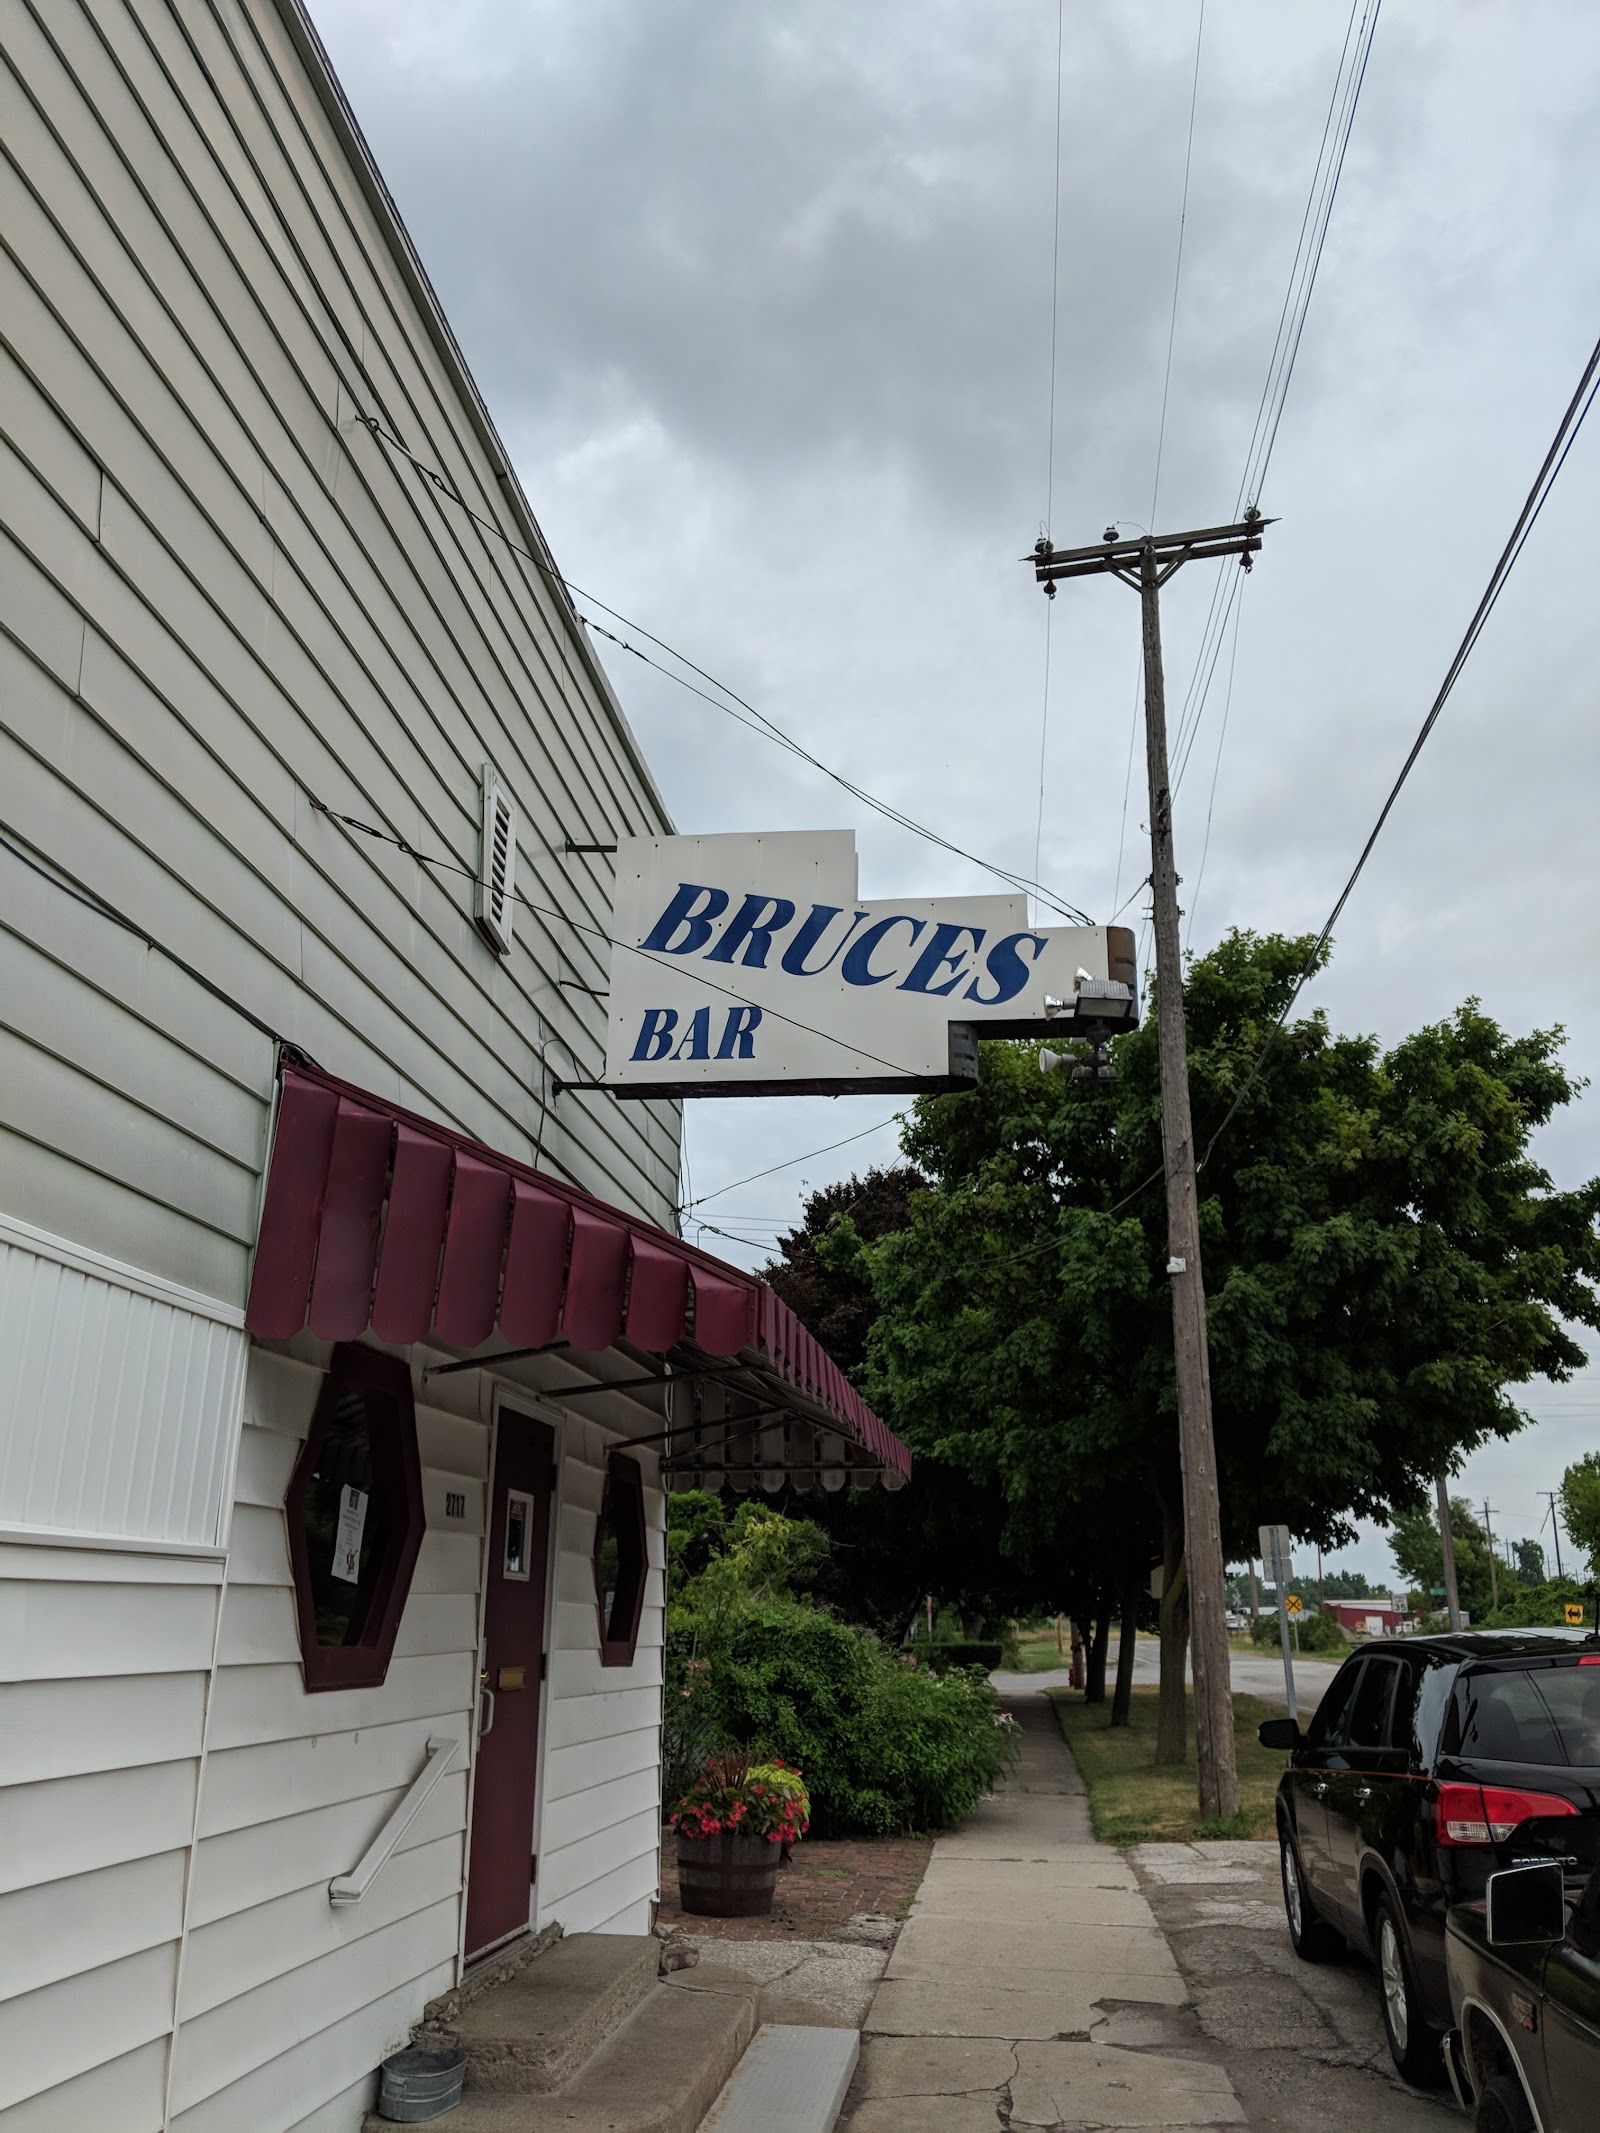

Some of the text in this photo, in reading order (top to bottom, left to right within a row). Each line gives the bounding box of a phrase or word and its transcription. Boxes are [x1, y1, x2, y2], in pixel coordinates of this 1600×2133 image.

[637, 883, 1049, 1006] BRUCES
[629, 1006, 763, 1061] BAR
[446, 1492, 465, 1519] 2717
[1394, 1603, 1407, 1612] 35
